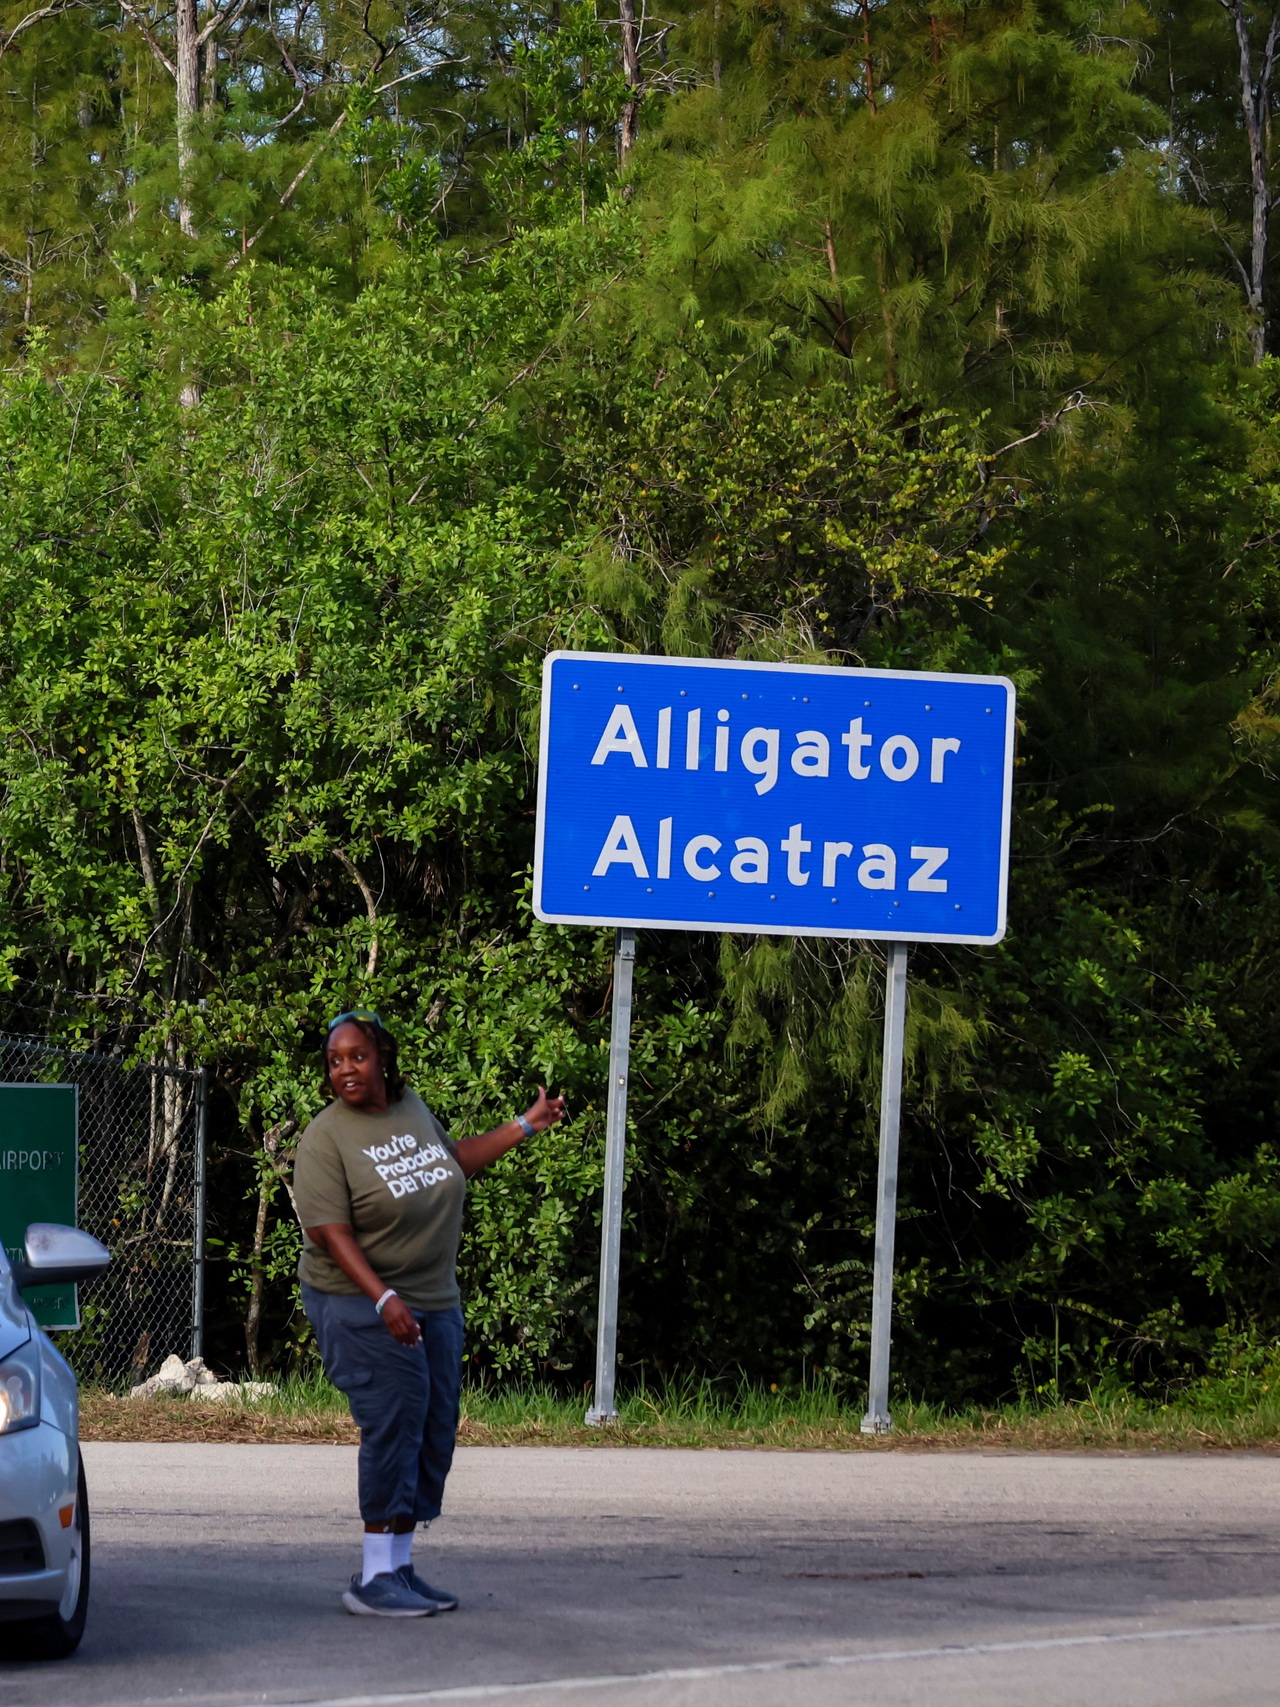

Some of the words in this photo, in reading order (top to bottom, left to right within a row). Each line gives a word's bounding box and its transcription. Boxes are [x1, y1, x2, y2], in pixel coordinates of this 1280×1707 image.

[590, 704, 961, 796] Alligator
[591, 815, 949, 893] Alcatraz
[362, 1134, 417, 1163] You're
[375, 1143, 448, 1180] Probably
[387, 1174, 419, 1198] DEI
